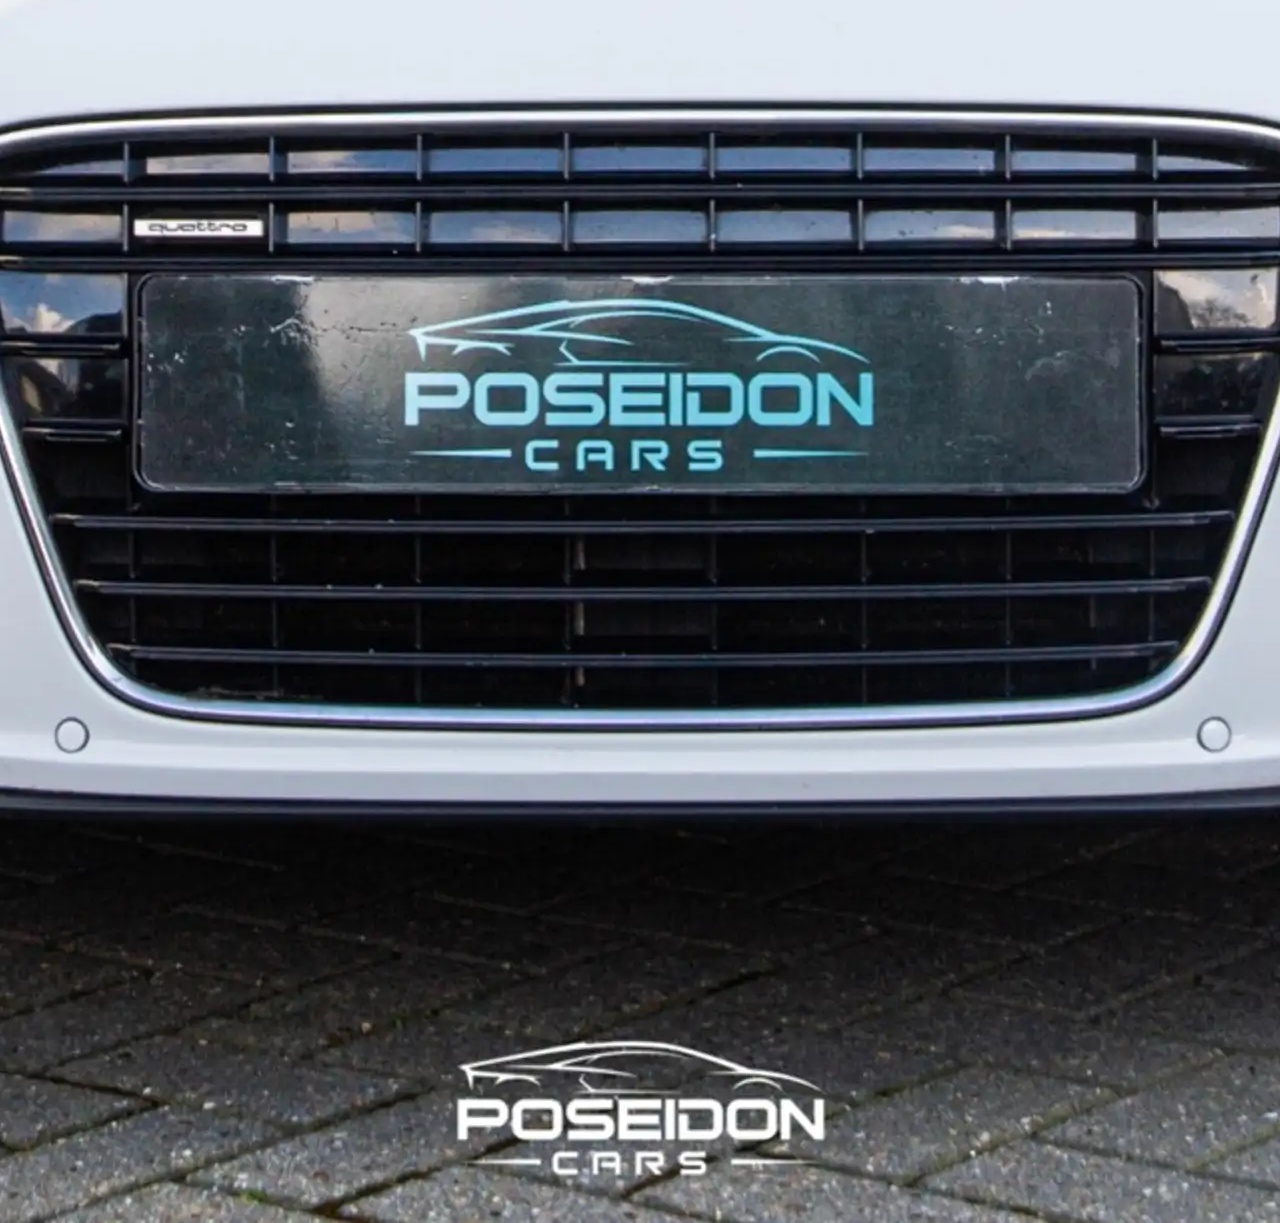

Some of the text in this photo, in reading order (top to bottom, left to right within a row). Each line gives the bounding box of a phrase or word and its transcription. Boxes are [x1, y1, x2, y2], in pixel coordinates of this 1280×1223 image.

[148, 222, 247, 234] quattro
[404, 372, 874, 426] POSEIDON
[524, 439, 724, 471] CARS
